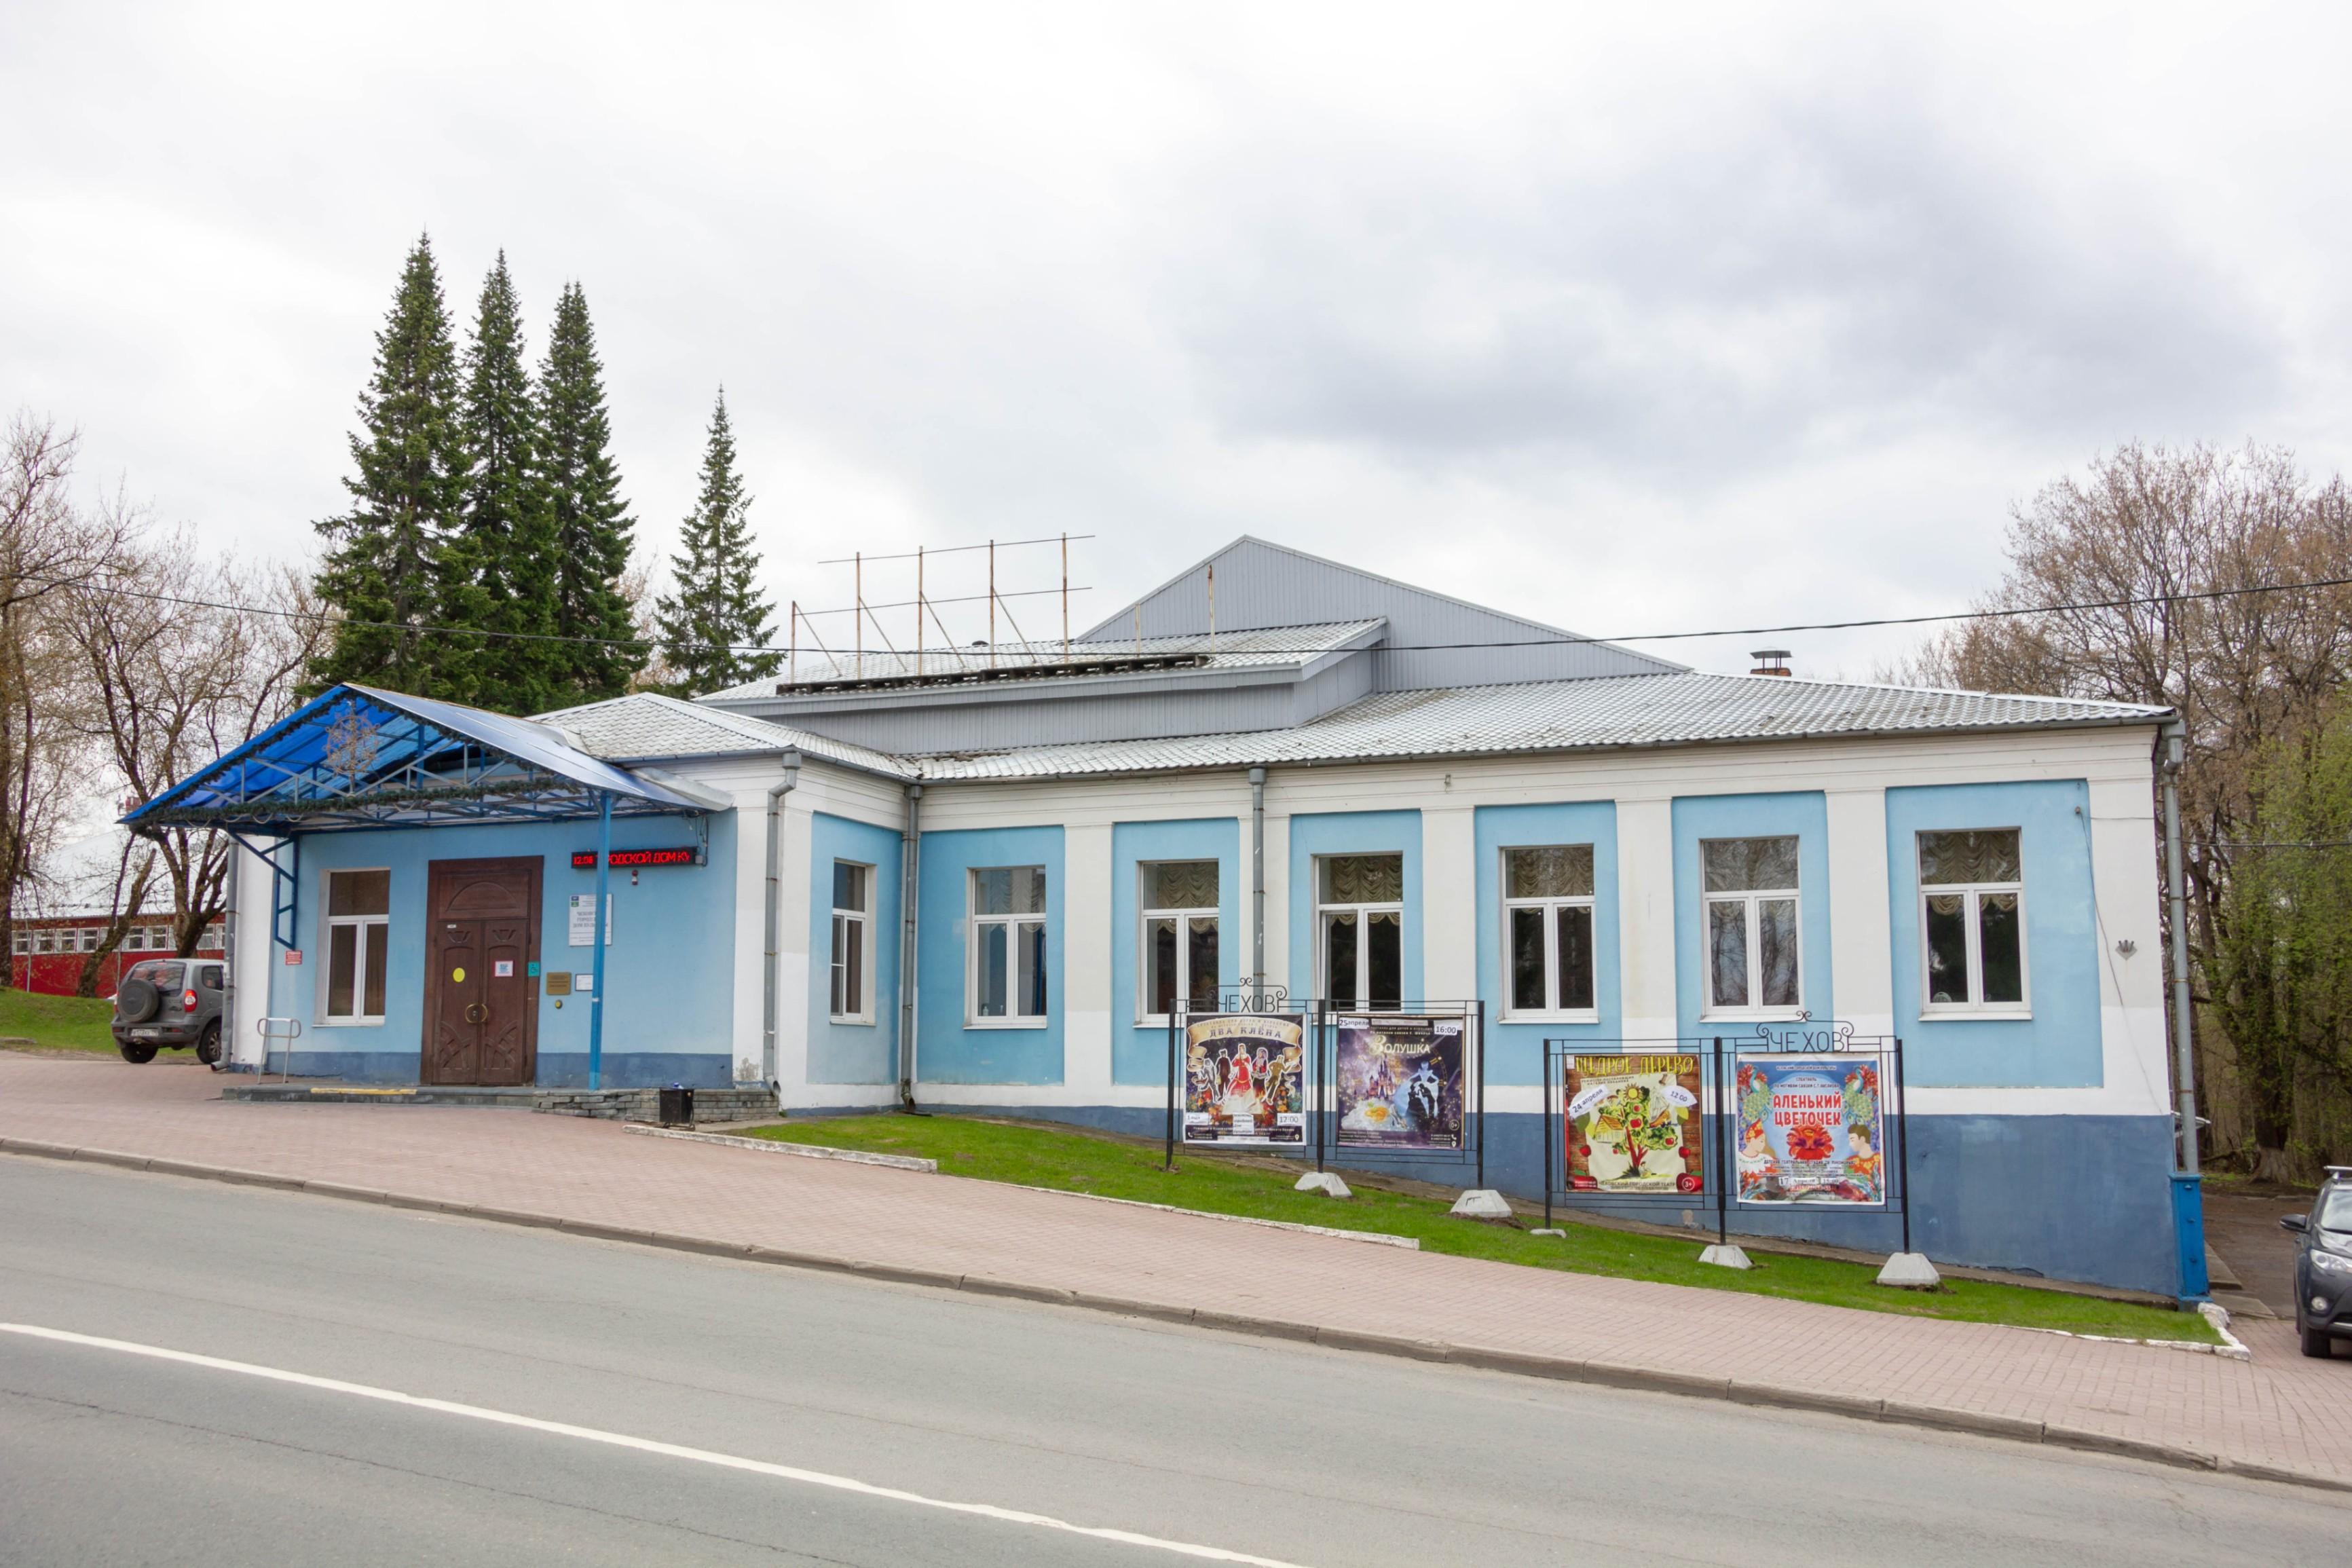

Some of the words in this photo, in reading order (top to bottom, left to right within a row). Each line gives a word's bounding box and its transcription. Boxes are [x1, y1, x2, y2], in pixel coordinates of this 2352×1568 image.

[654, 851, 676, 863] ДОМ
[1217, 994, 1275, 1013] ЧЕХОВ
[1210, 1028, 1233, 1038] ДВА
[1436, 1026, 1457, 1034] 16:00
[1770, 1031, 1844, 1052] ЧЕХОВ
[1575, 1056, 1631, 1077] ЩЕДРОЕ
[1640, 1056, 1694, 1077] ДЕРЕВО
[1572, 1103, 1582, 1113] 24
[1582, 1089, 1603, 1105] апреля
[1773, 1091, 1842, 1108] АЛЕНЬКИЙ
[1774, 1112, 1842, 1127] ЦВЕТОЧЕК
